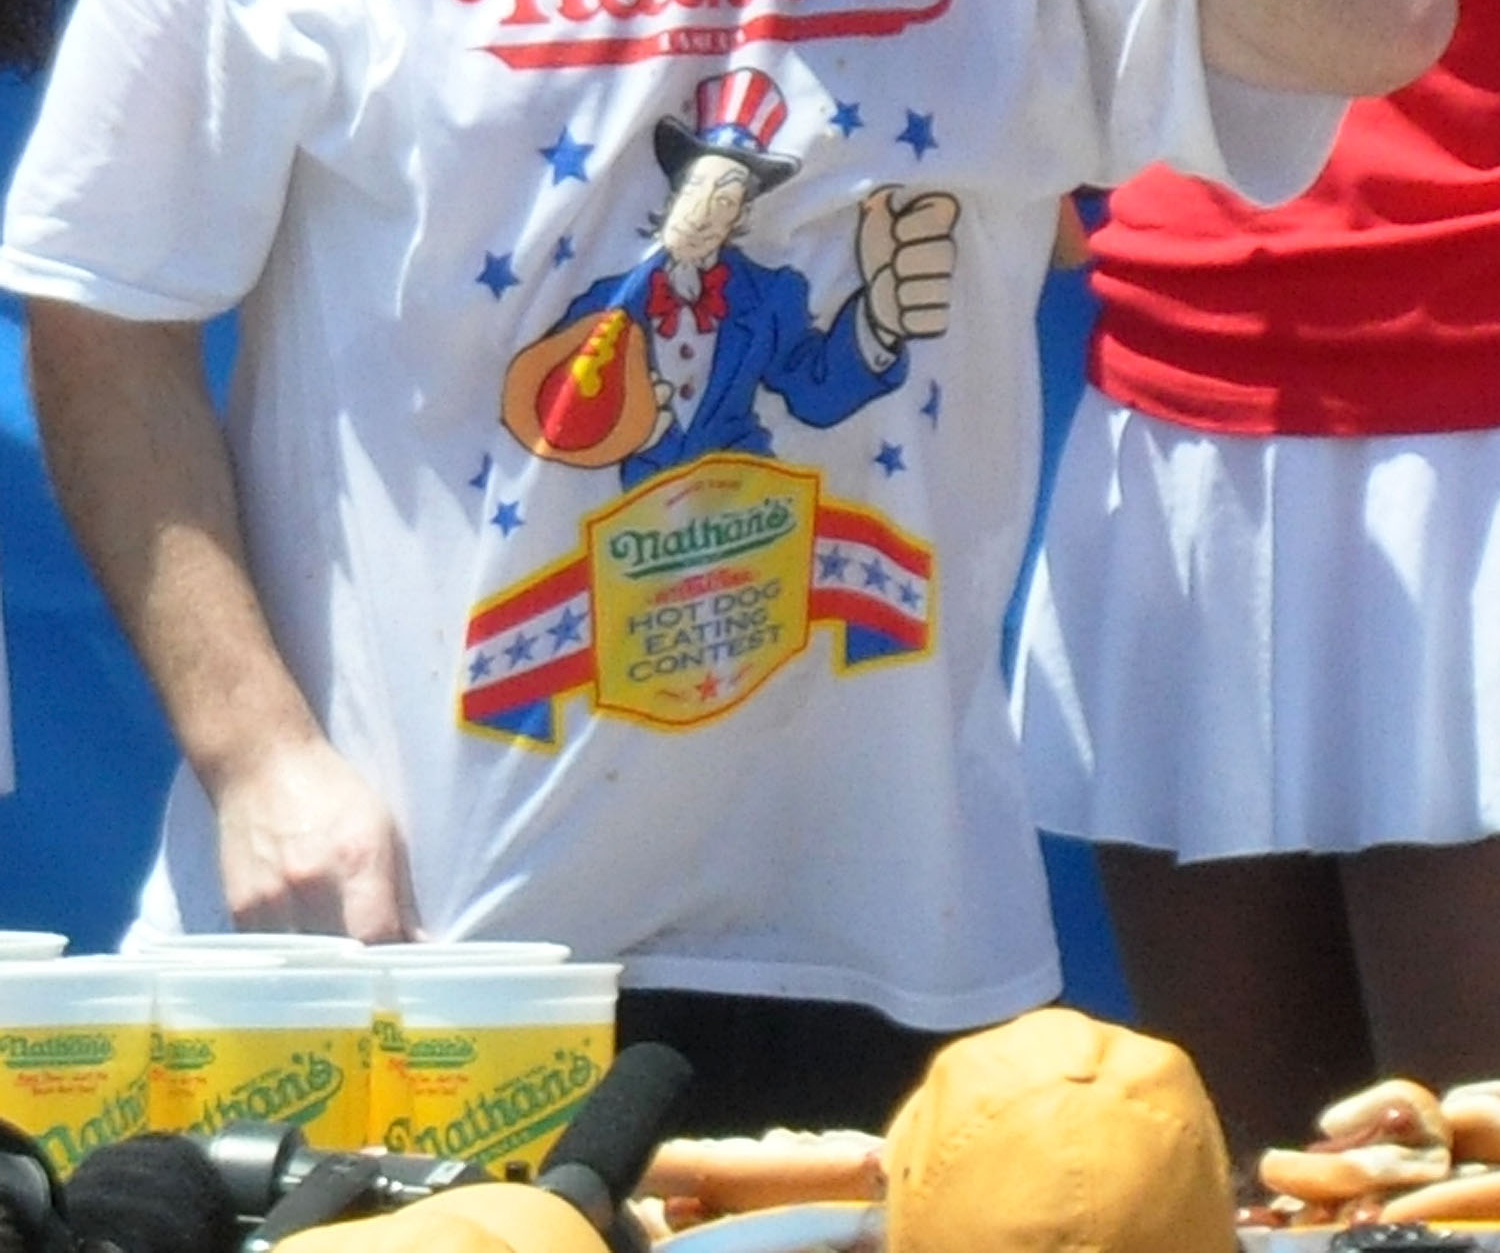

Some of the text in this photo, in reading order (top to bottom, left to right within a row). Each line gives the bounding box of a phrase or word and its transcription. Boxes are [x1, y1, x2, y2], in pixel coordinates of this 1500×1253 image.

[610, 497, 790, 568] Nathan's
[627, 601, 705, 635] HOT
[713, 578, 782, 615] DOG
[644, 607, 770, 656] EATING
[627, 624, 782, 683] CONTEST
